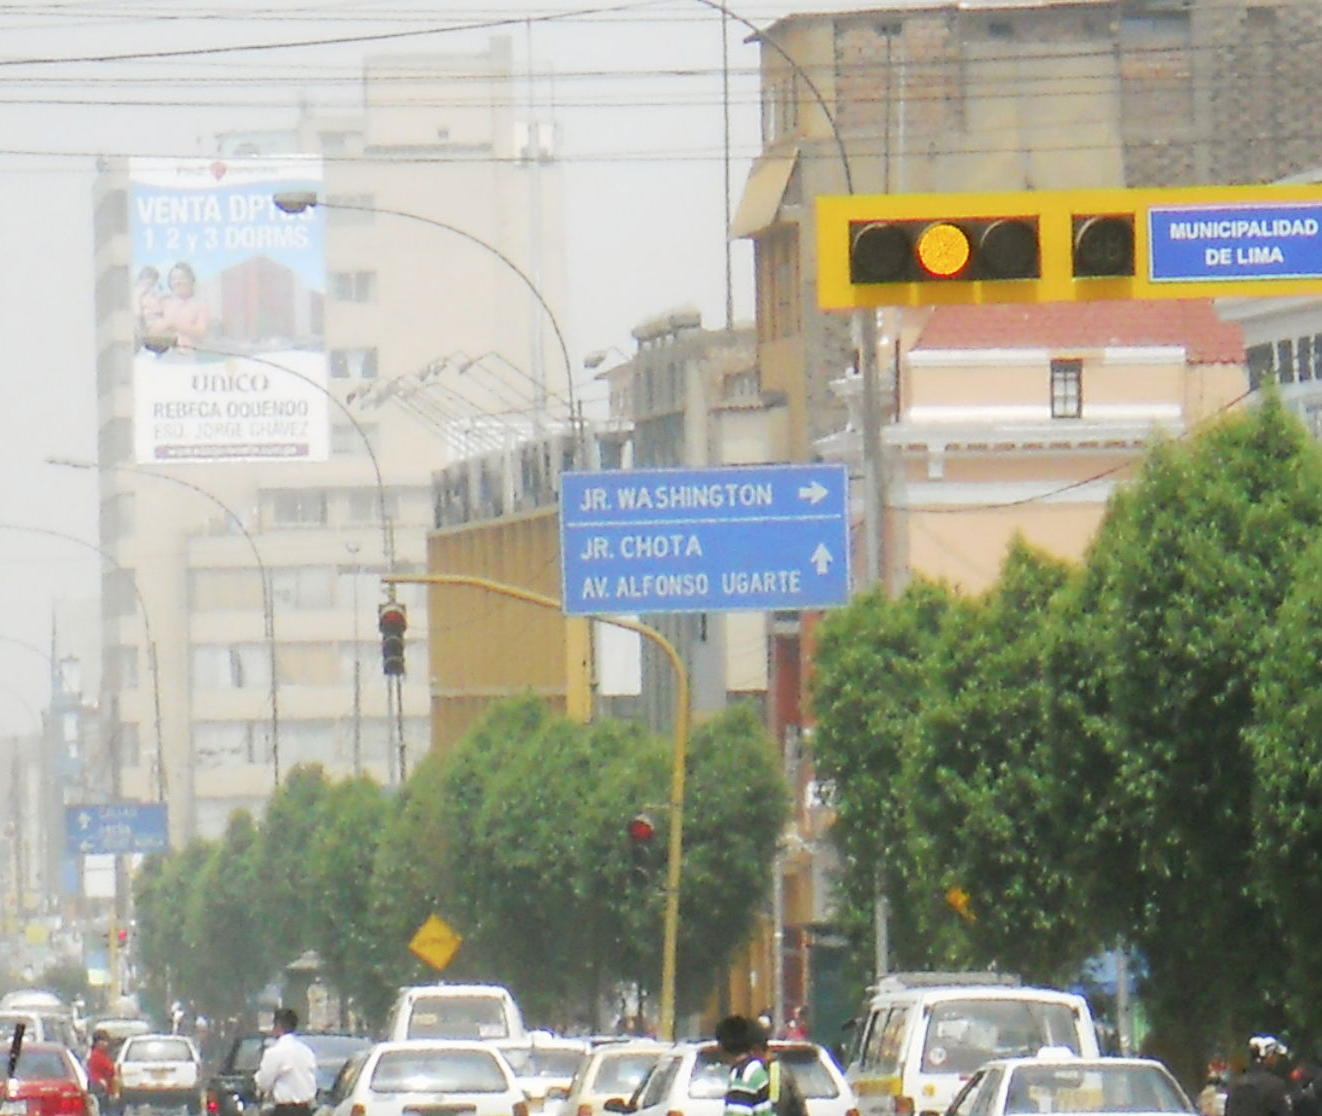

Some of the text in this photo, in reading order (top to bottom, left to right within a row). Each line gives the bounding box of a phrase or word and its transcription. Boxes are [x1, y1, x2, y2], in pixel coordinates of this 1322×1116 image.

[136, 194, 316, 224] VENTA DPT
[204, 227, 219, 249] 3
[1170, 219, 1319, 240] MUNICIPALIDAD
[1205, 246, 1284, 265] DE LIMA
[152, 400, 309, 419] REBECA OQUENDO
[196, 422, 242, 438] JORGE
[580, 483, 772, 511] JR. WASHINGTON
[581, 535, 703, 561] JR. CHOTA
[582, 570, 801, 599] AV. ALFONSO UGARTE
